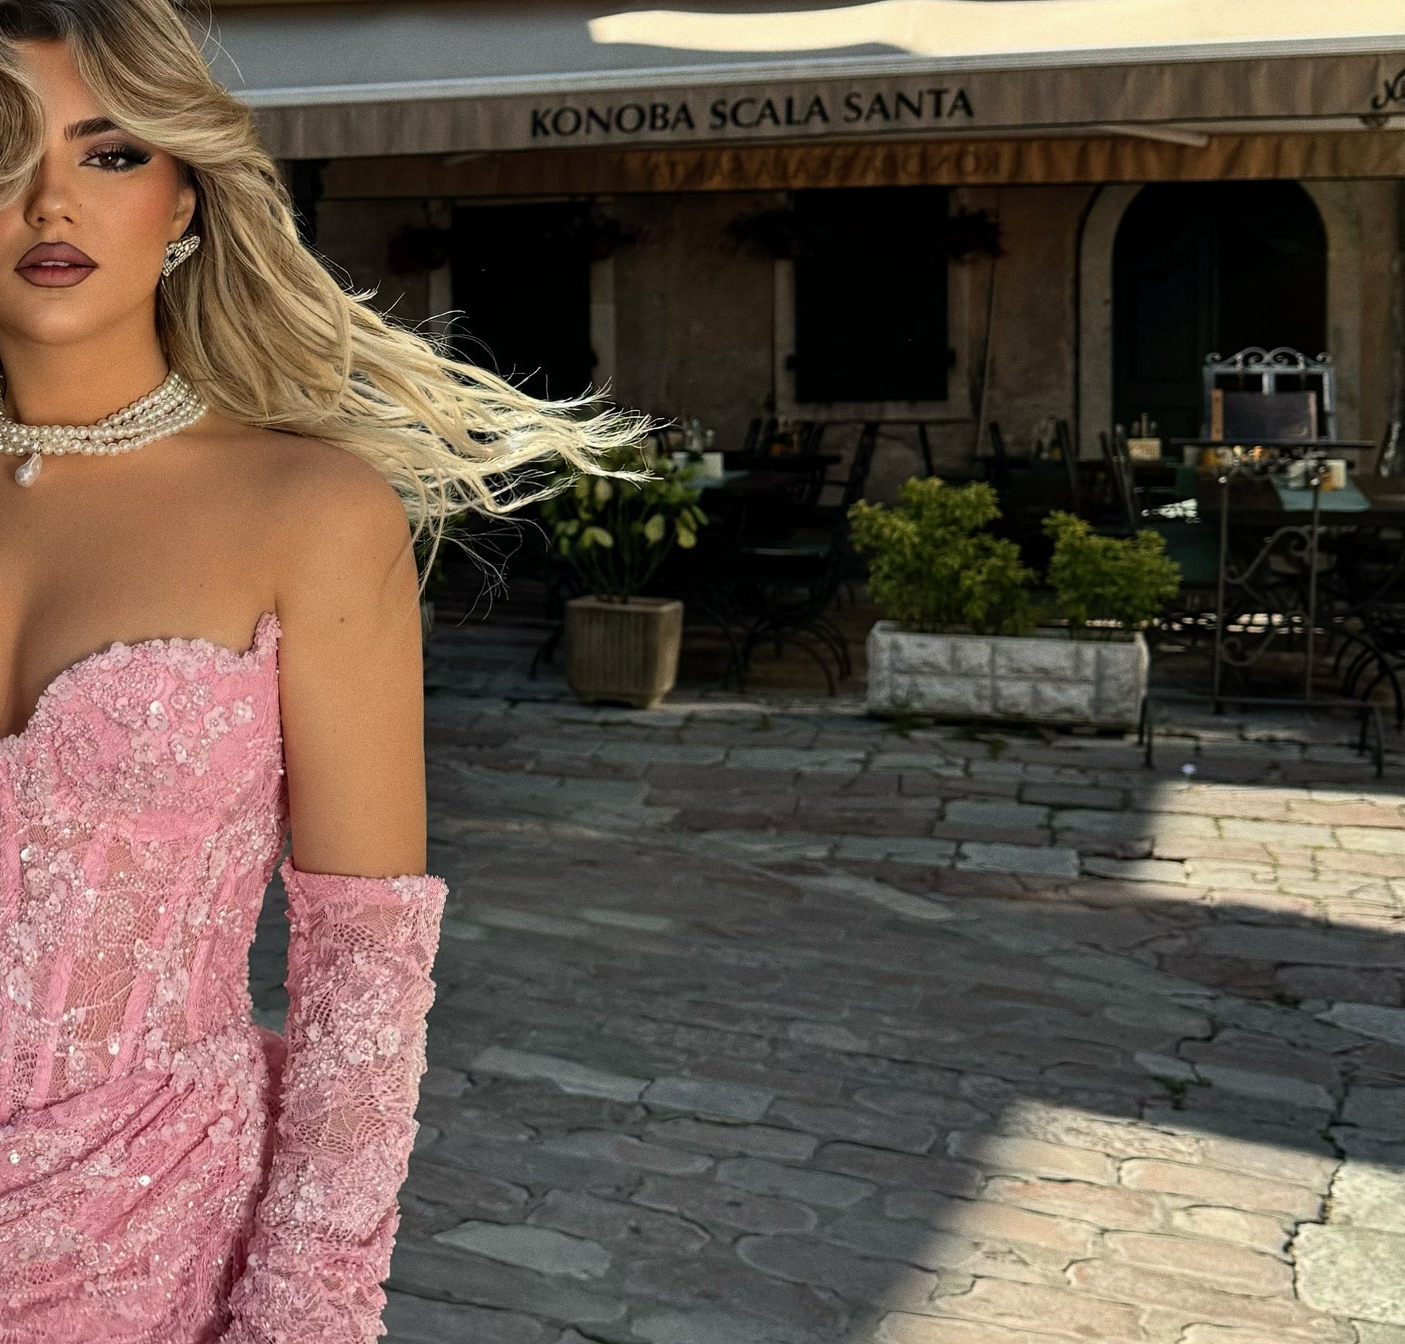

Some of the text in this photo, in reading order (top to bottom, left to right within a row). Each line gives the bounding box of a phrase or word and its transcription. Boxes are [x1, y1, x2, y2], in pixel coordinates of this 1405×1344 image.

[531, 89, 974, 138] KONOBA SCALA SANTA
